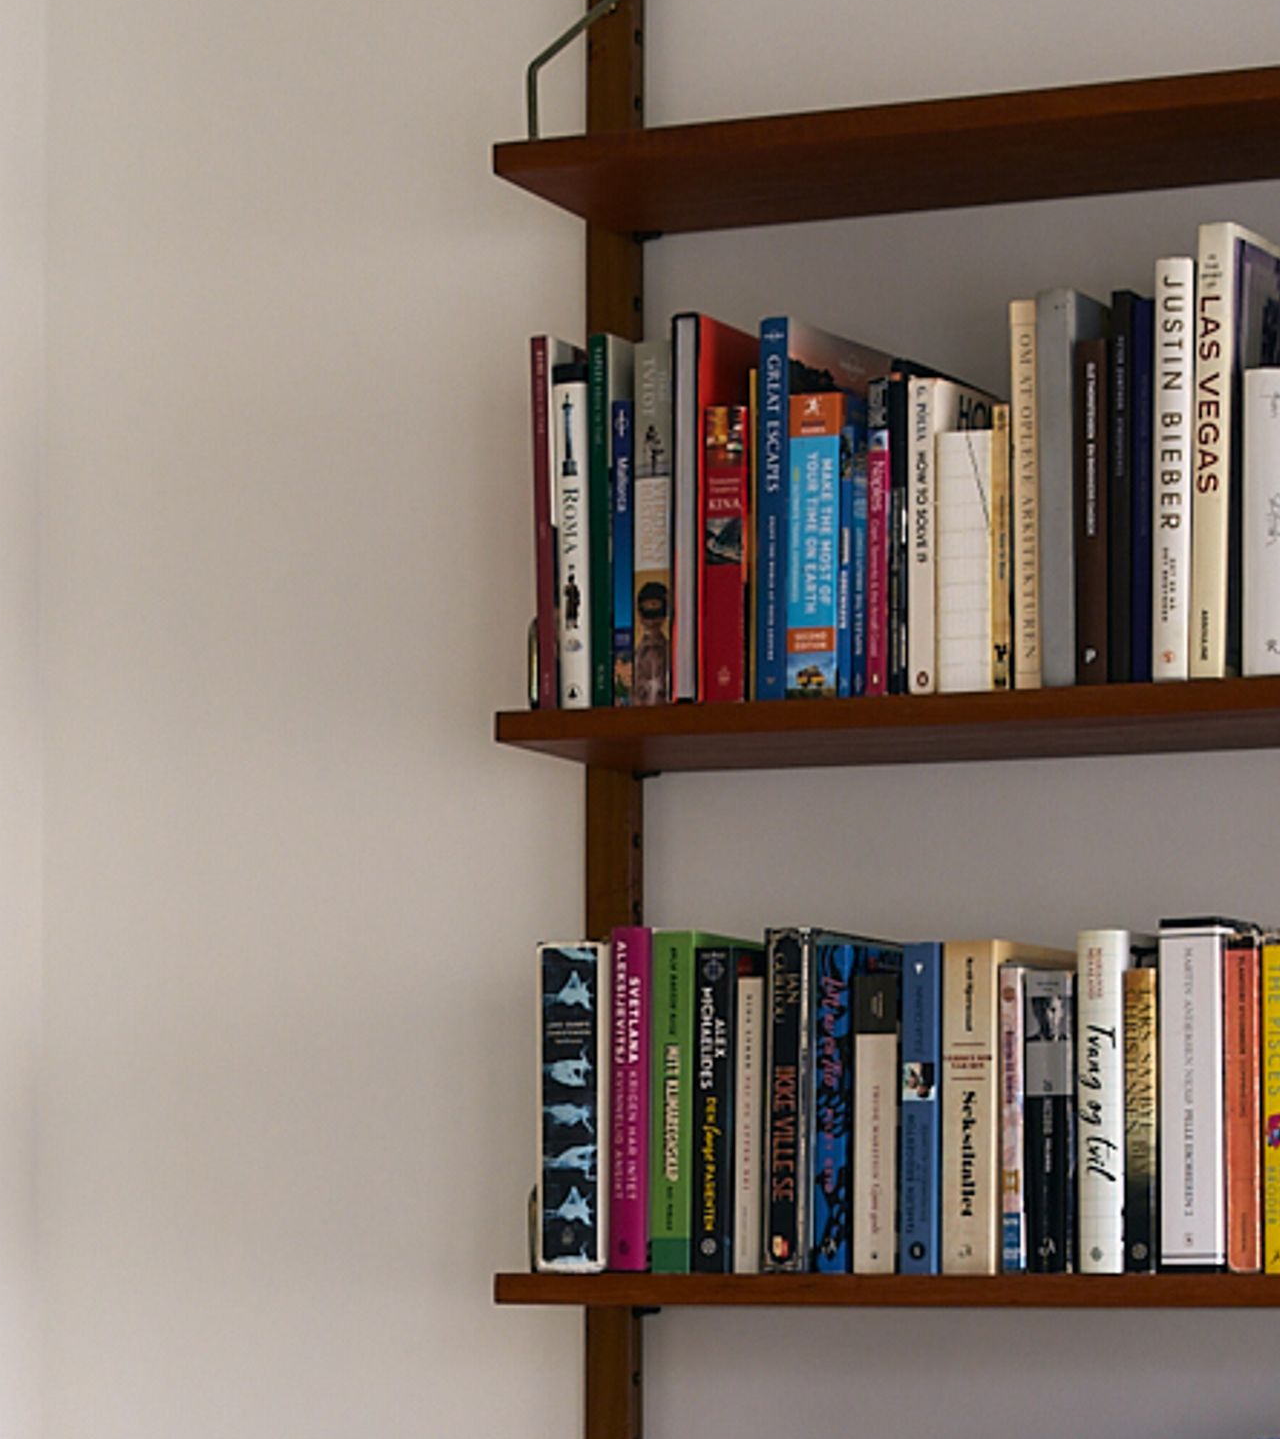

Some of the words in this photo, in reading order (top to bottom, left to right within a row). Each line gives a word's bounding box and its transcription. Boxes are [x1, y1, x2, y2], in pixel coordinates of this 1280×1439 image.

[1020, 335, 1032, 364] OM
[1161, 275, 1185, 388] JUSTIN
[1198, 295, 1221, 361] LAS
[766, 353, 783, 413] GREAT
[1020, 372, 1033, 396] AT
[765, 420, 782, 493] ESCAPES
[1020, 406, 1035, 483] OPLEVE
[1196, 372, 1221, 494] VEGAS
[615, 456, 631, 513] Mallorca
[807, 452, 821, 491] YOUR
[870, 461, 885, 512] Naples
[1160, 413, 1183, 530] BIEBER
[561, 488, 582, 555] ROMA
[806, 497, 819, 531] TIME
[806, 537, 818, 558] ON
[804, 563, 819, 614] EARTH
[1021, 497, 1038, 660] ARKITEKTUREN
[614, 941, 627, 1064] ALEKSIJEVITSJ
[628, 976, 640, 1064] SVETLANA
[699, 987, 713, 1090] MICHAELIDES
[715, 1017, 727, 1059] ALEX
[1080, 1024, 1116, 1091] Tvang
[627, 1070, 638, 1122] KRIGEN
[773, 1065, 796, 1111] IKKE
[1081, 1100, 1104, 1126] og
[627, 1126, 638, 1156] HAR
[773, 1115, 793, 1174] VILLE
[959, 1091, 977, 1218] Sekstitallet
[1086, 1137, 1118, 1183] tvil
[627, 1160, 637, 1201] INTET
[774, 1179, 794, 1202] SE
